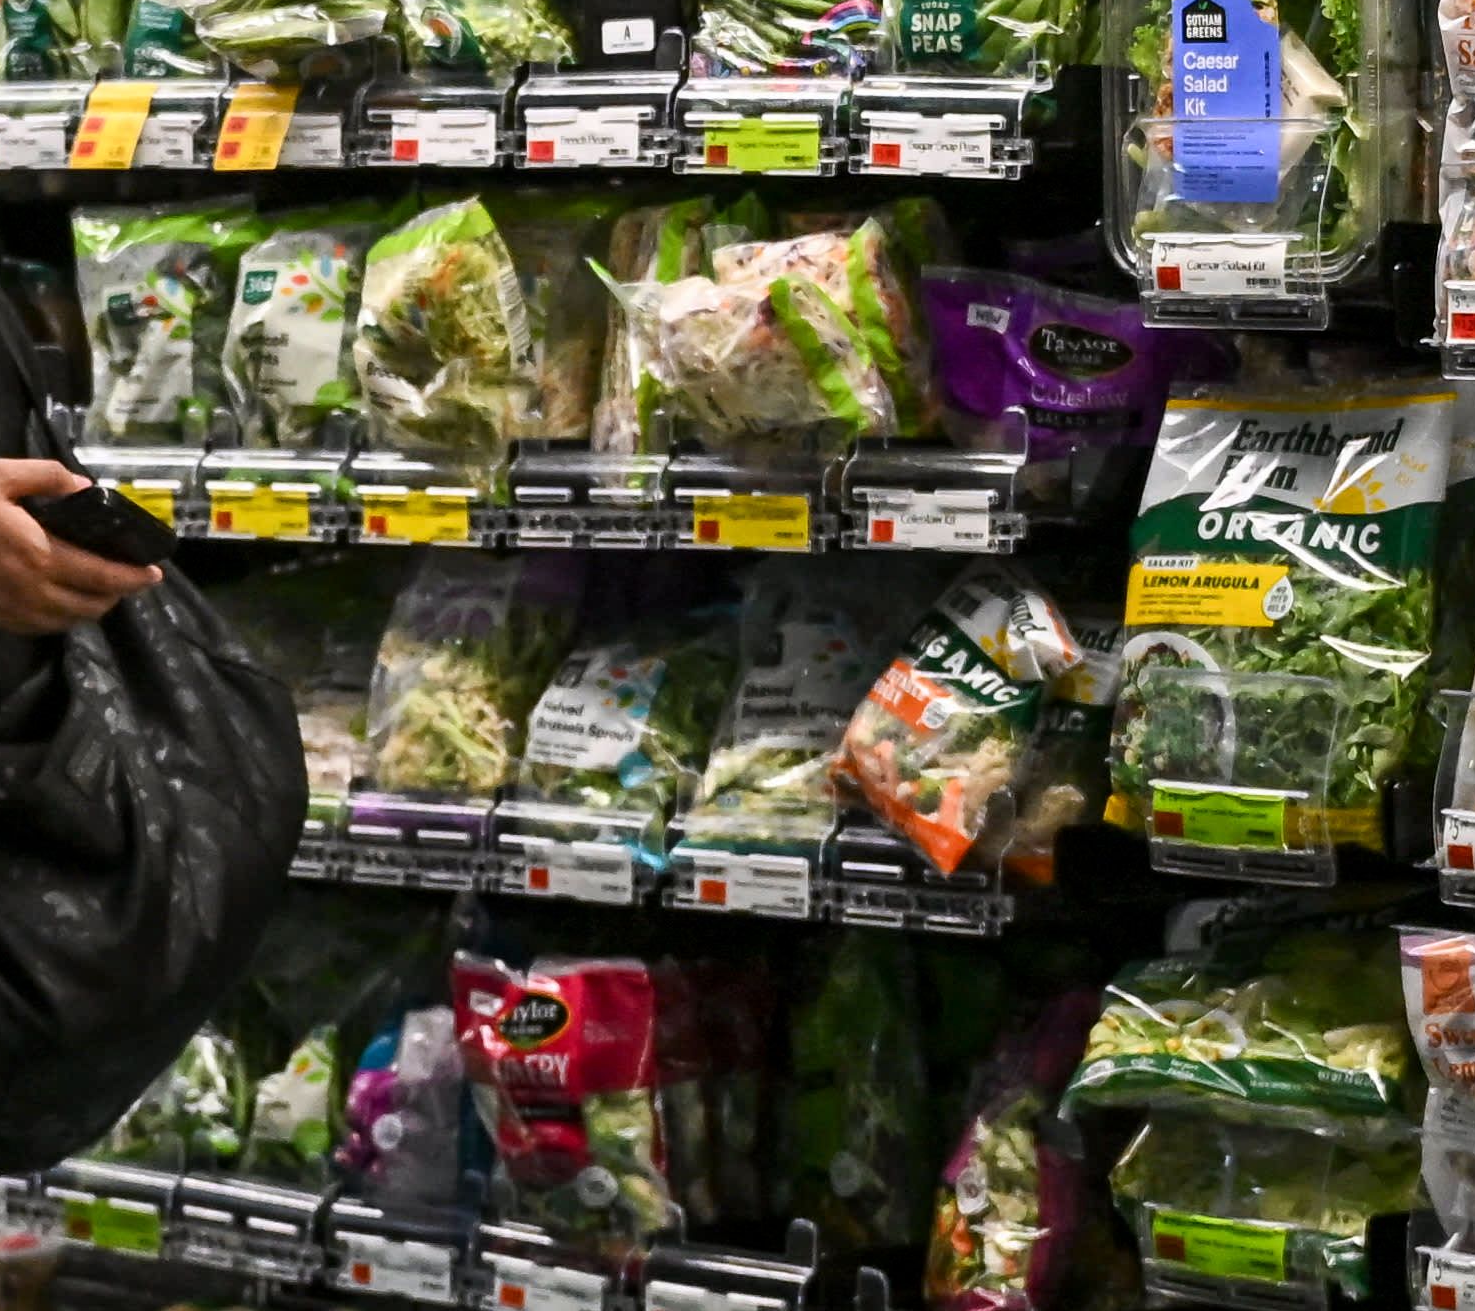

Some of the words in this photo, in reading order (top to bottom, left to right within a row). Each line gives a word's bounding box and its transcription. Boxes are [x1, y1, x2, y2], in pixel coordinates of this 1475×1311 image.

[911, 13, 961, 32] SNAP
[1185, 12, 1223, 27] GOTHAM
[1185, 24, 1223, 39] GREENS
[912, 35, 963, 53] PEAS
[1183, 51, 1240, 71] Caesar
[1183, 74, 1228, 94] Salad
[1185, 97, 1207, 117] Kit
[1143, 575, 1190, 588] LEMON
[1193, 575, 1260, 589] ARUGULA
